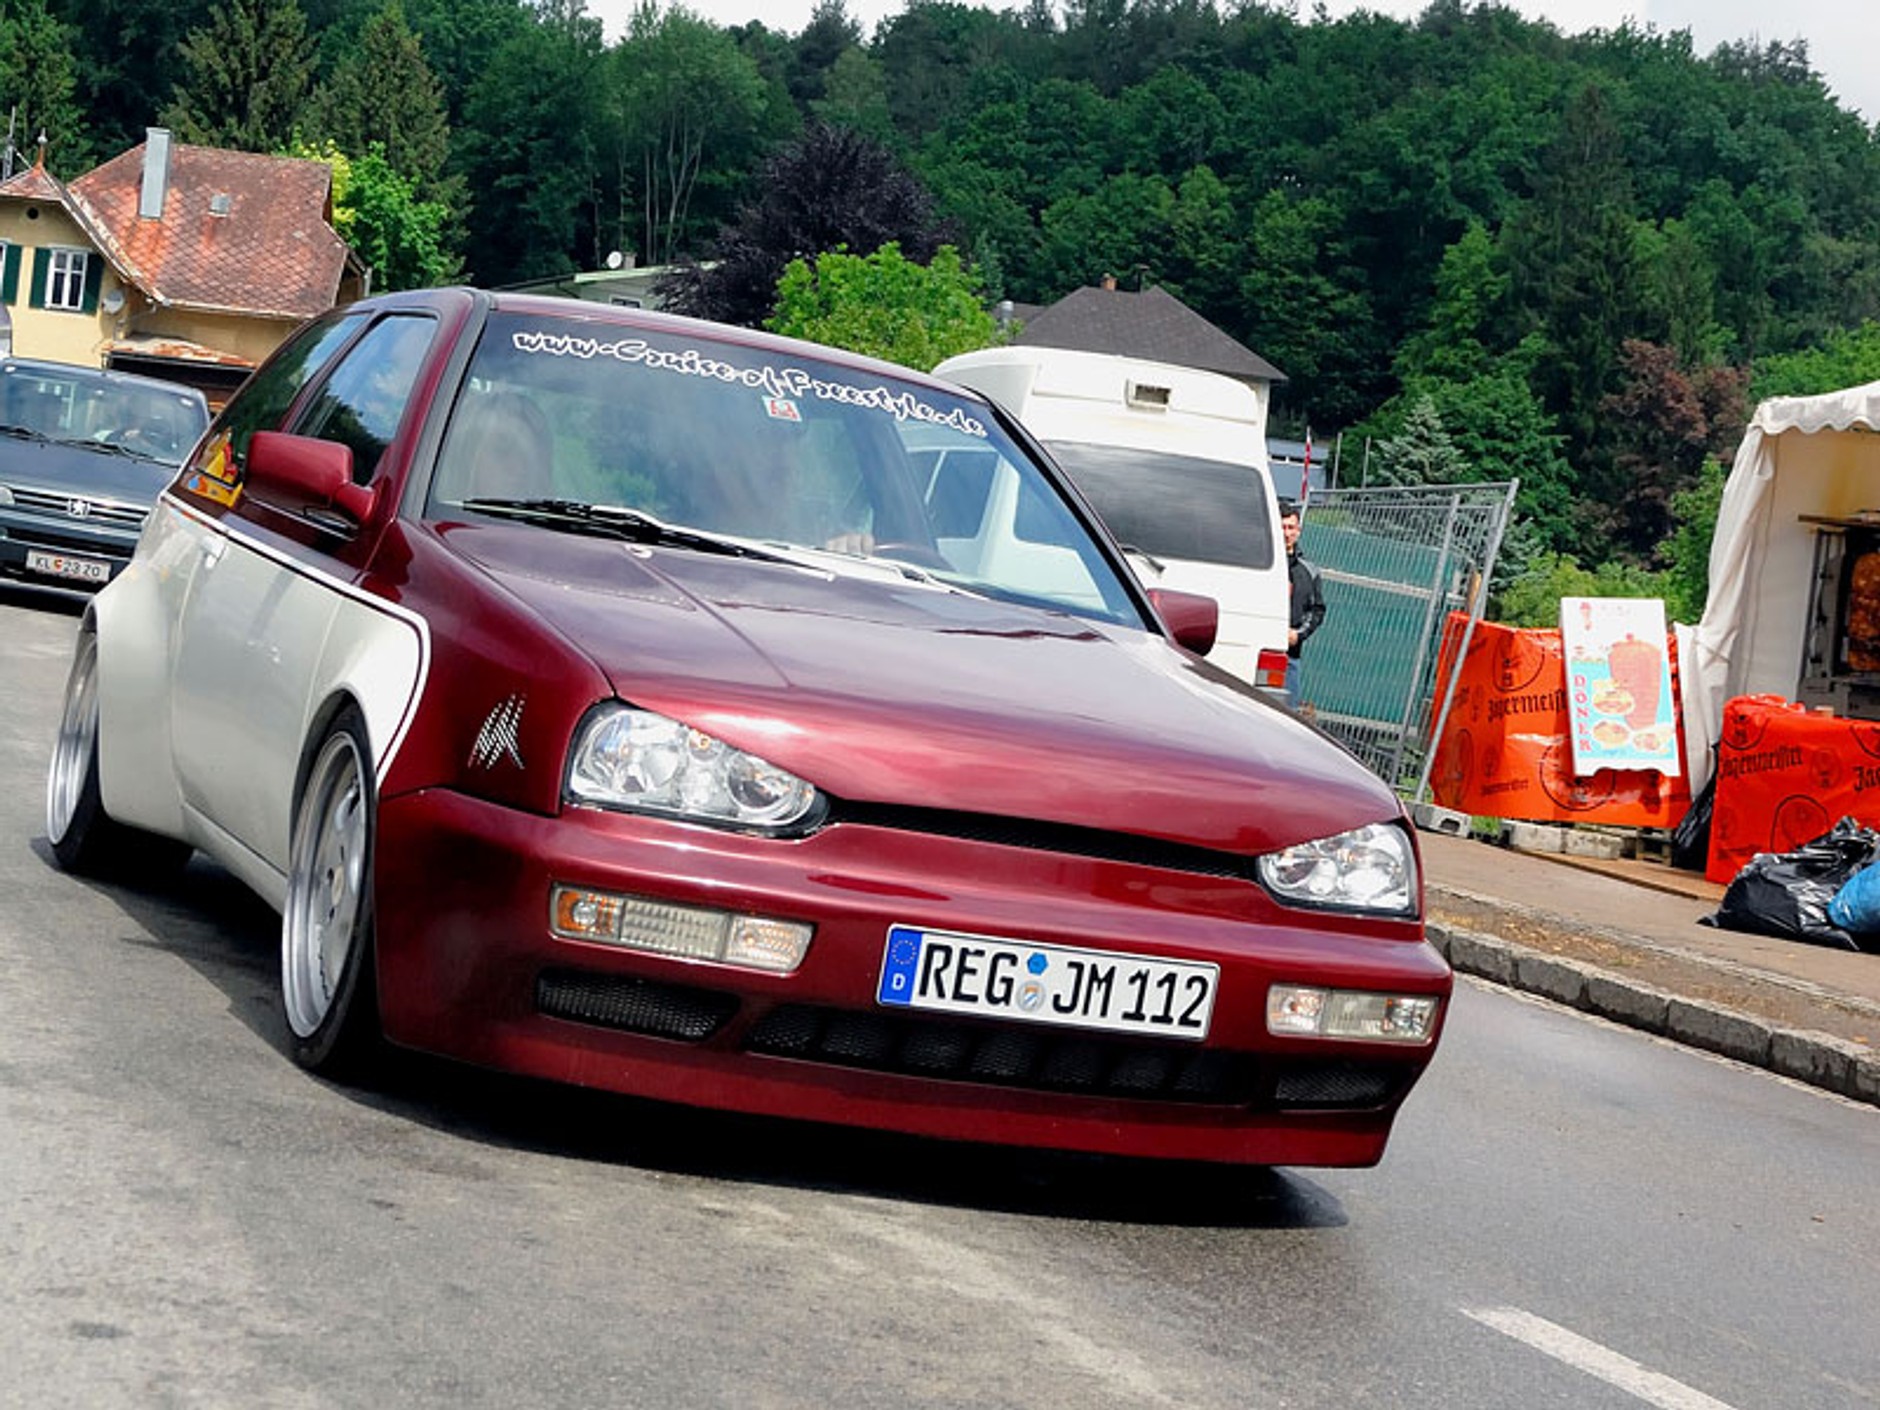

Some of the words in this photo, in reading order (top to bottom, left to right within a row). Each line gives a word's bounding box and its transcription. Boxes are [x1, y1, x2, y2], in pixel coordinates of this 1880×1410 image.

[891, 972, 906, 991] D
[918, 942, 1019, 1007] REG
[1052, 961, 1117, 1018] JM
[1121, 968, 1210, 1028] 112
